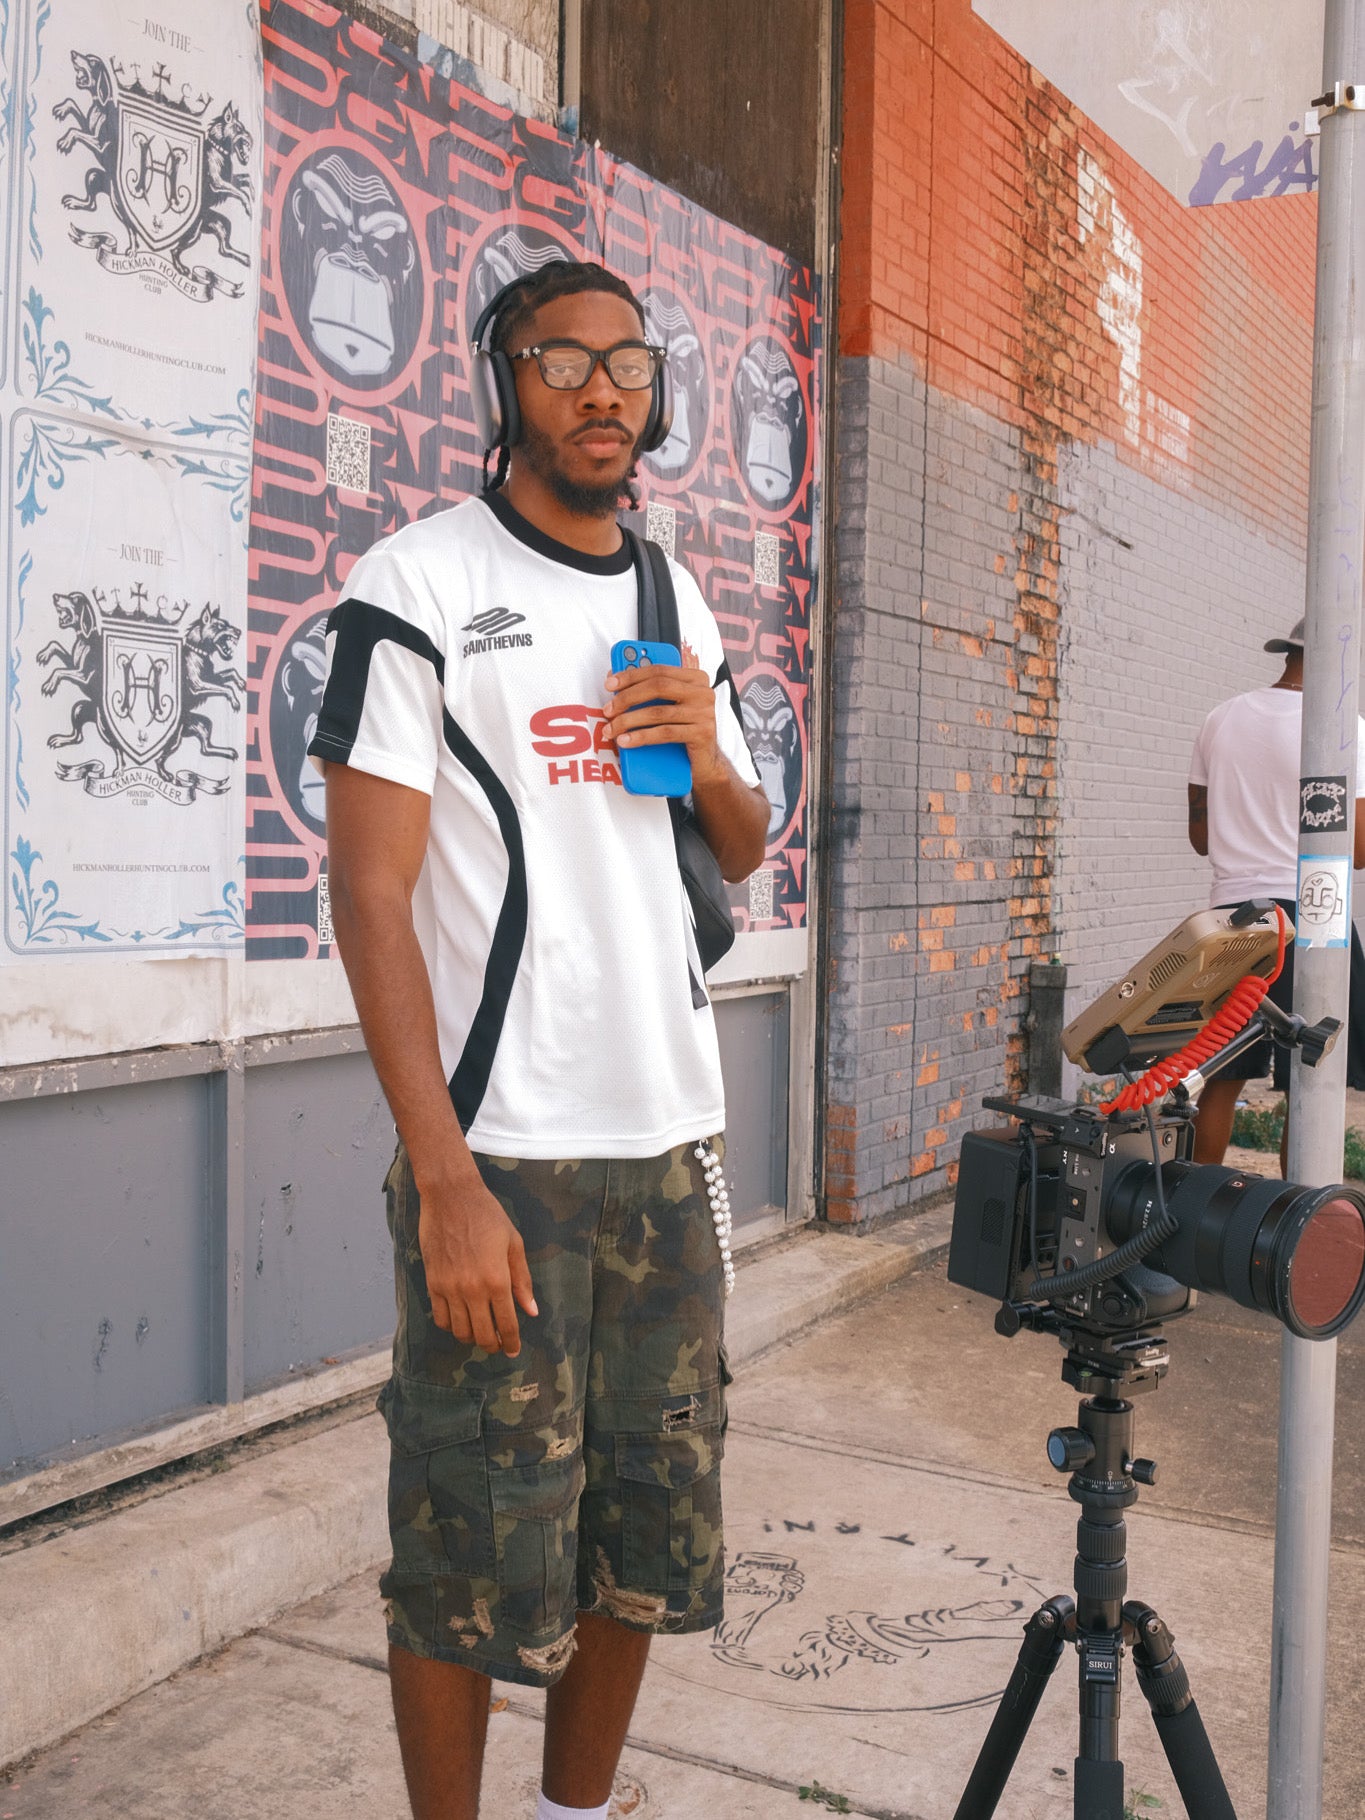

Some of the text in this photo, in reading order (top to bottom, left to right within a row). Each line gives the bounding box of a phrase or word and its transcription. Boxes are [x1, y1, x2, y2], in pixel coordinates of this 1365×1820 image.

[142, 19, 191, 53] JOIN THE
[112, 255, 198, 297] HICKMAN HOLLER
[139, 274, 168, 288] HUNTING
[144, 283, 162, 295] CLUB
[85, 331, 226, 375] HICKMANHOLLERHUNTINGCLUB.COM
[120, 544, 164, 567] JOIN THE
[463, 633, 533, 659] SAINTHEVNS
[99, 772, 182, 802] HICKMAN HOLLER
[126, 789, 155, 798] HUNTING
[72, 862, 210, 873] HICKMANHOLLERHUNTINGCLUB.COM
[1088, 1660, 1113, 1670] SIRUI
